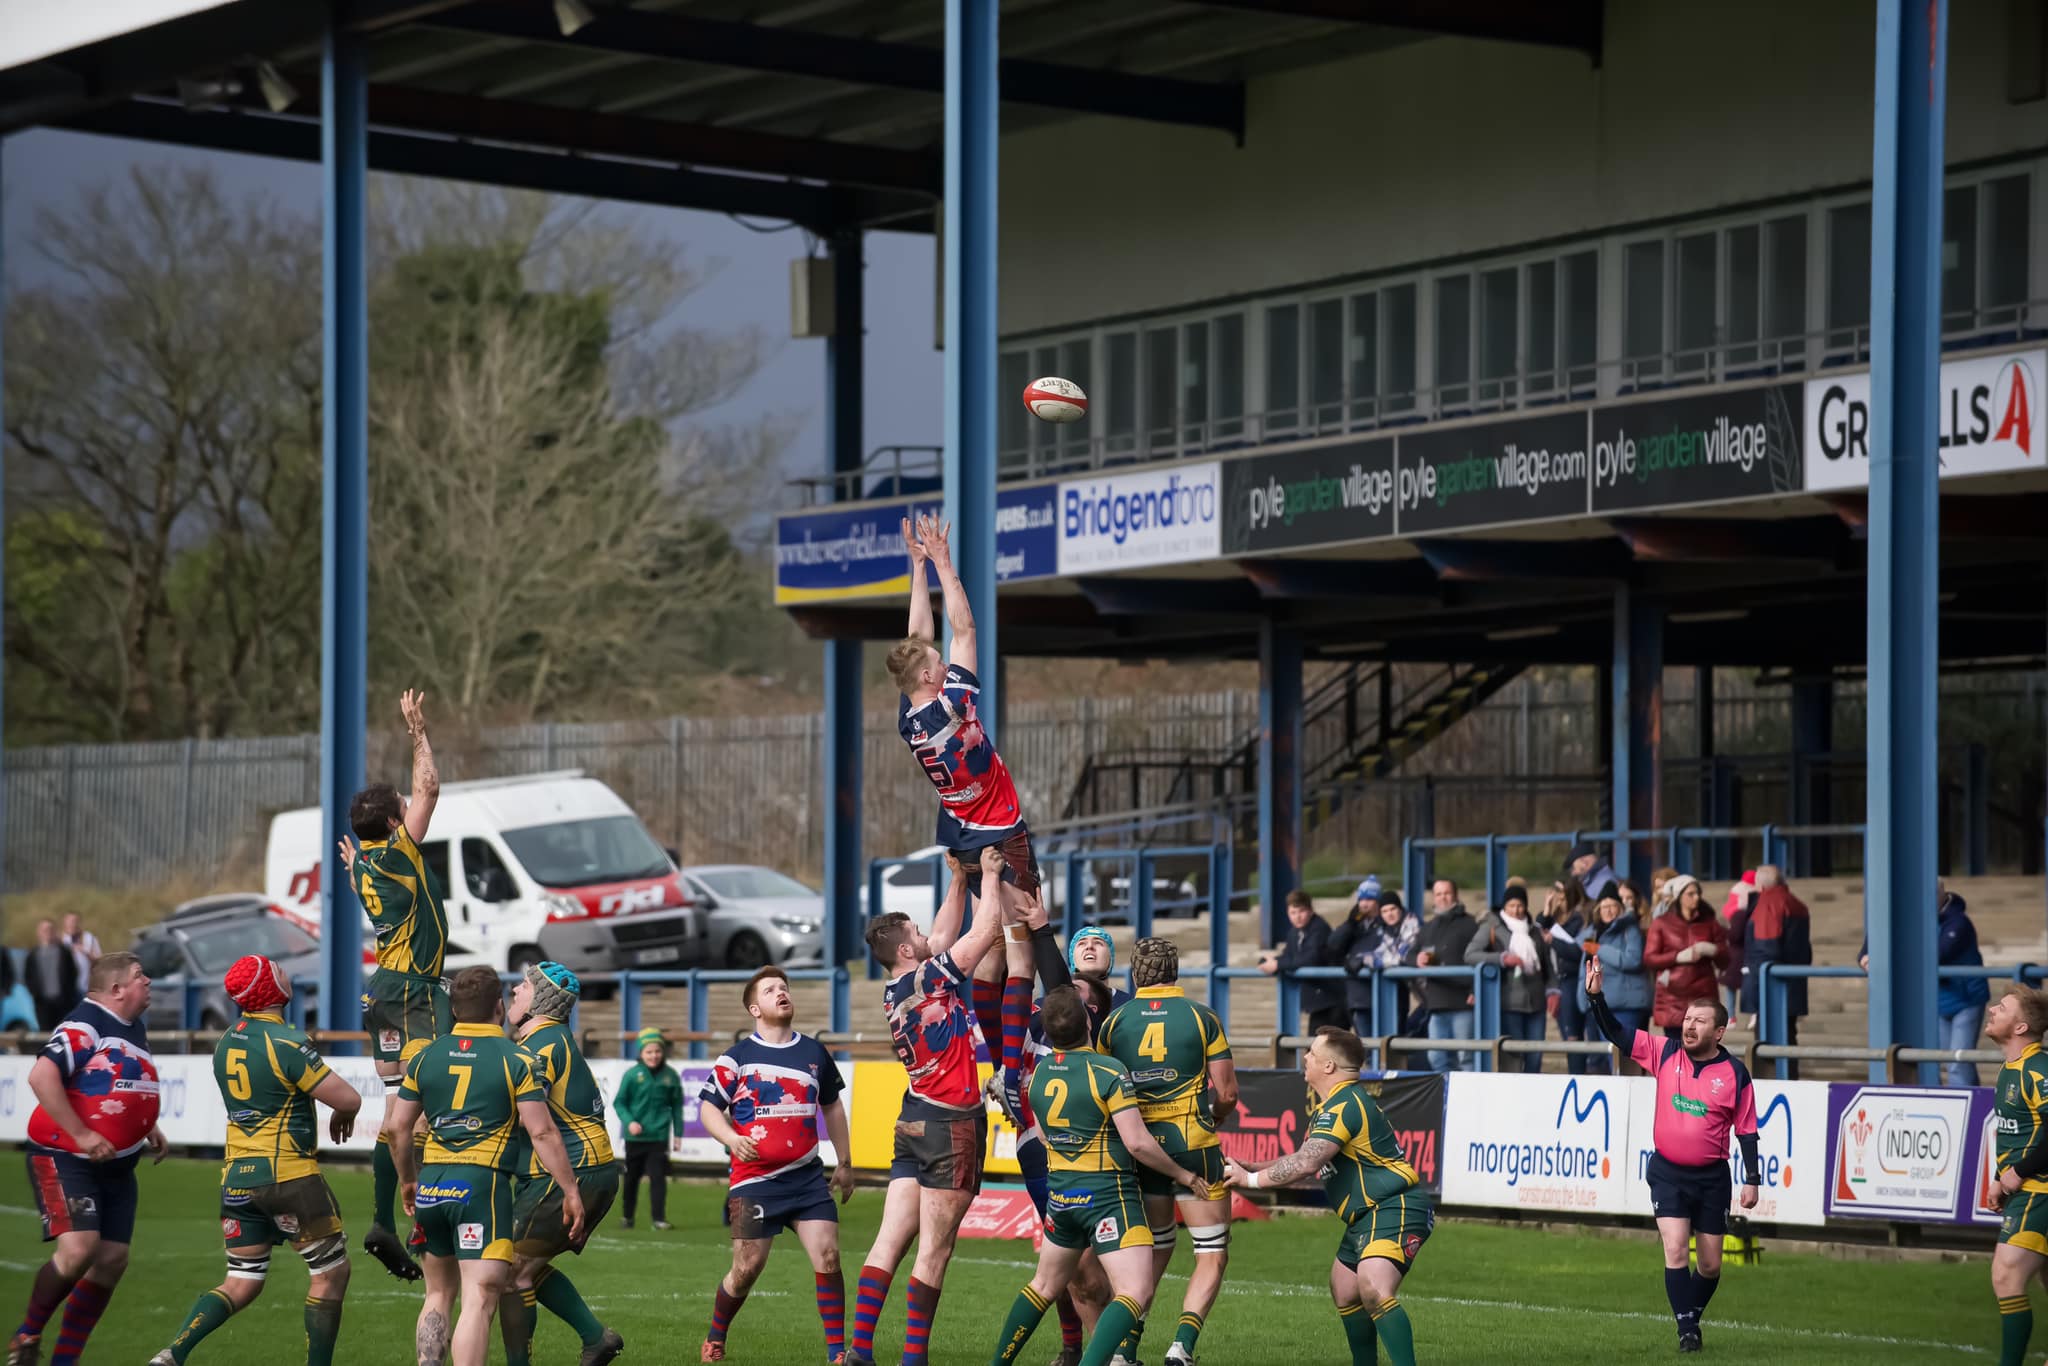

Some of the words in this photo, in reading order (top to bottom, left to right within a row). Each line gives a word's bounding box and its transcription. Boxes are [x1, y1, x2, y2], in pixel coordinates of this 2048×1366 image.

[1138, 1021, 1168, 1063] 4
[115, 1081, 133, 1089] CM
[226, 1047, 252, 1101] 5
[448, 1064, 473, 1111] 7
[756, 1107, 770, 1116] CM
[1044, 1078, 1070, 1128] 2
[1886, 1130, 1942, 1160] INDIGO
